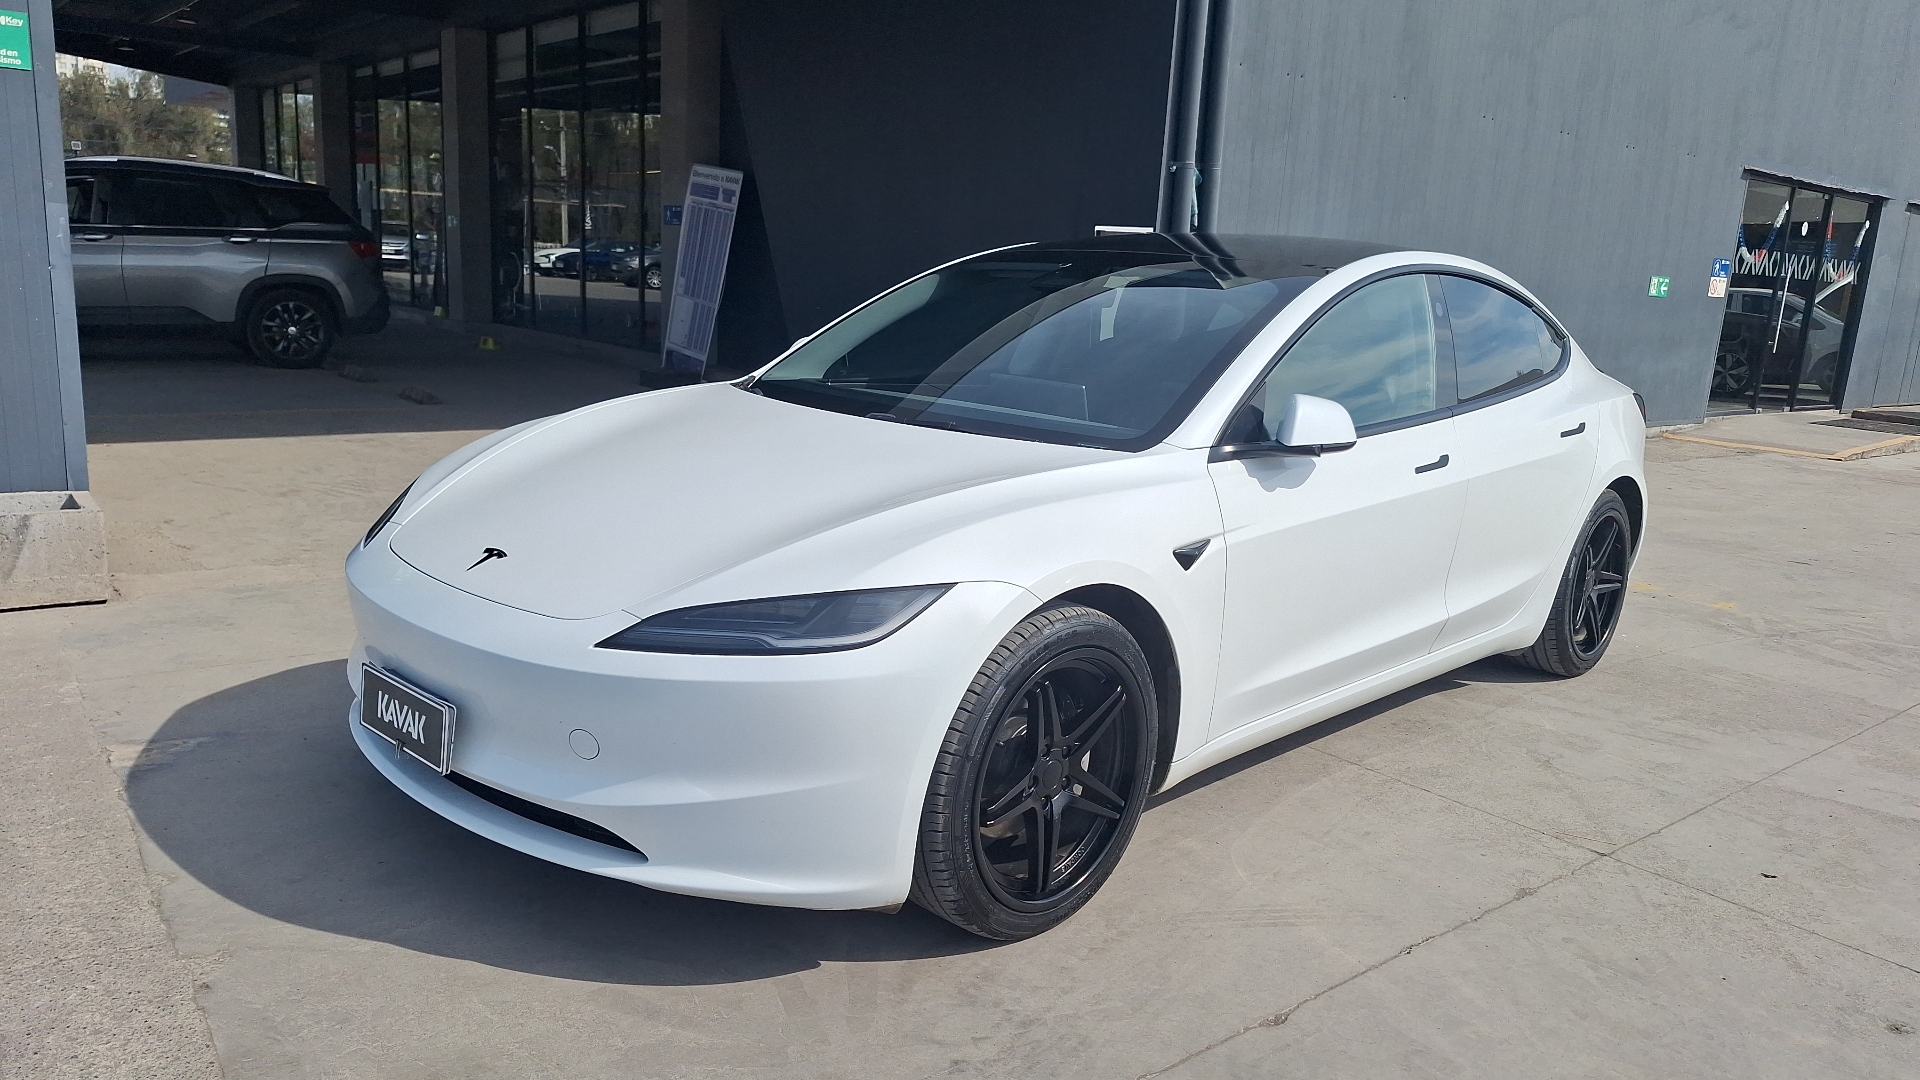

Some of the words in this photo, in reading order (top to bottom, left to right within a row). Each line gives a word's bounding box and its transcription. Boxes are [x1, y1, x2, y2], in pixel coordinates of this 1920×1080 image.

[5, 15, 24, 27] Key
[0, 55, 22, 65] ismo
[377, 690, 427, 745] KAVAK
